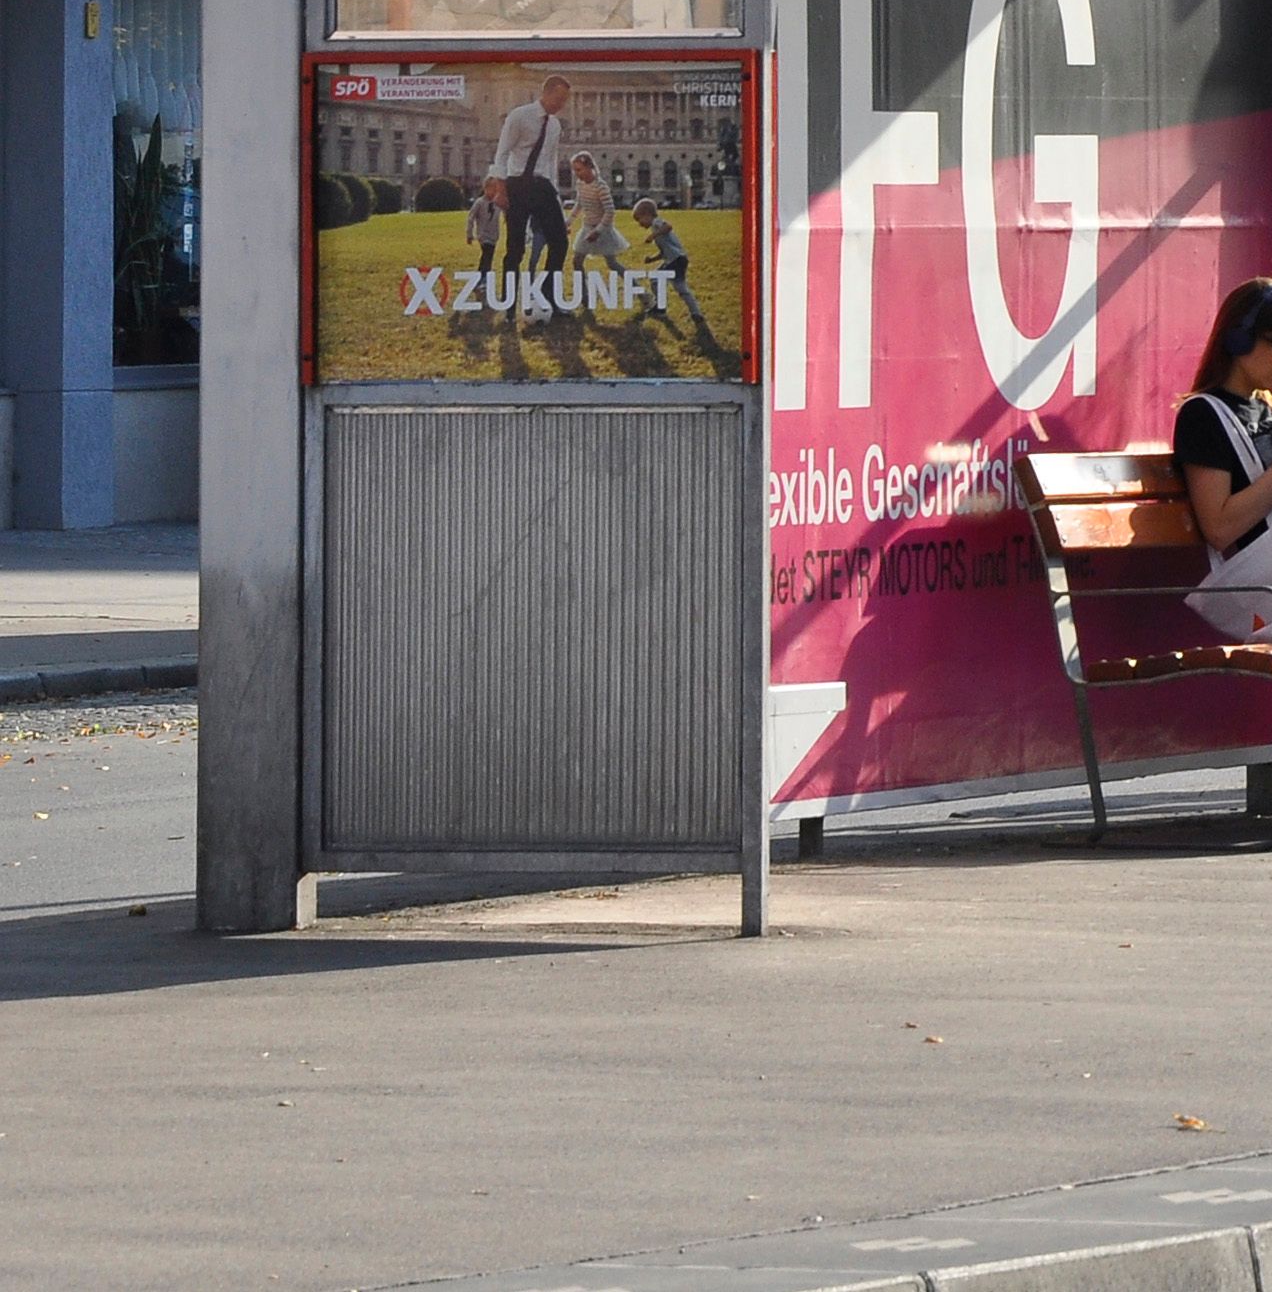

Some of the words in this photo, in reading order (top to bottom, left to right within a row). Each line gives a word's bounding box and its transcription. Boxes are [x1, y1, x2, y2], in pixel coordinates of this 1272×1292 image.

[334, 78, 371, 97] SPÖ
[446, 76, 463, 86] MIT
[673, 82, 742, 95] CHRISTIAN
[700, 94, 738, 107] KERN
[452, 269, 677, 311] ZUKUNFT
[802, 546, 872, 604] STEYR
[878, 538, 967, 598] MOTORS
